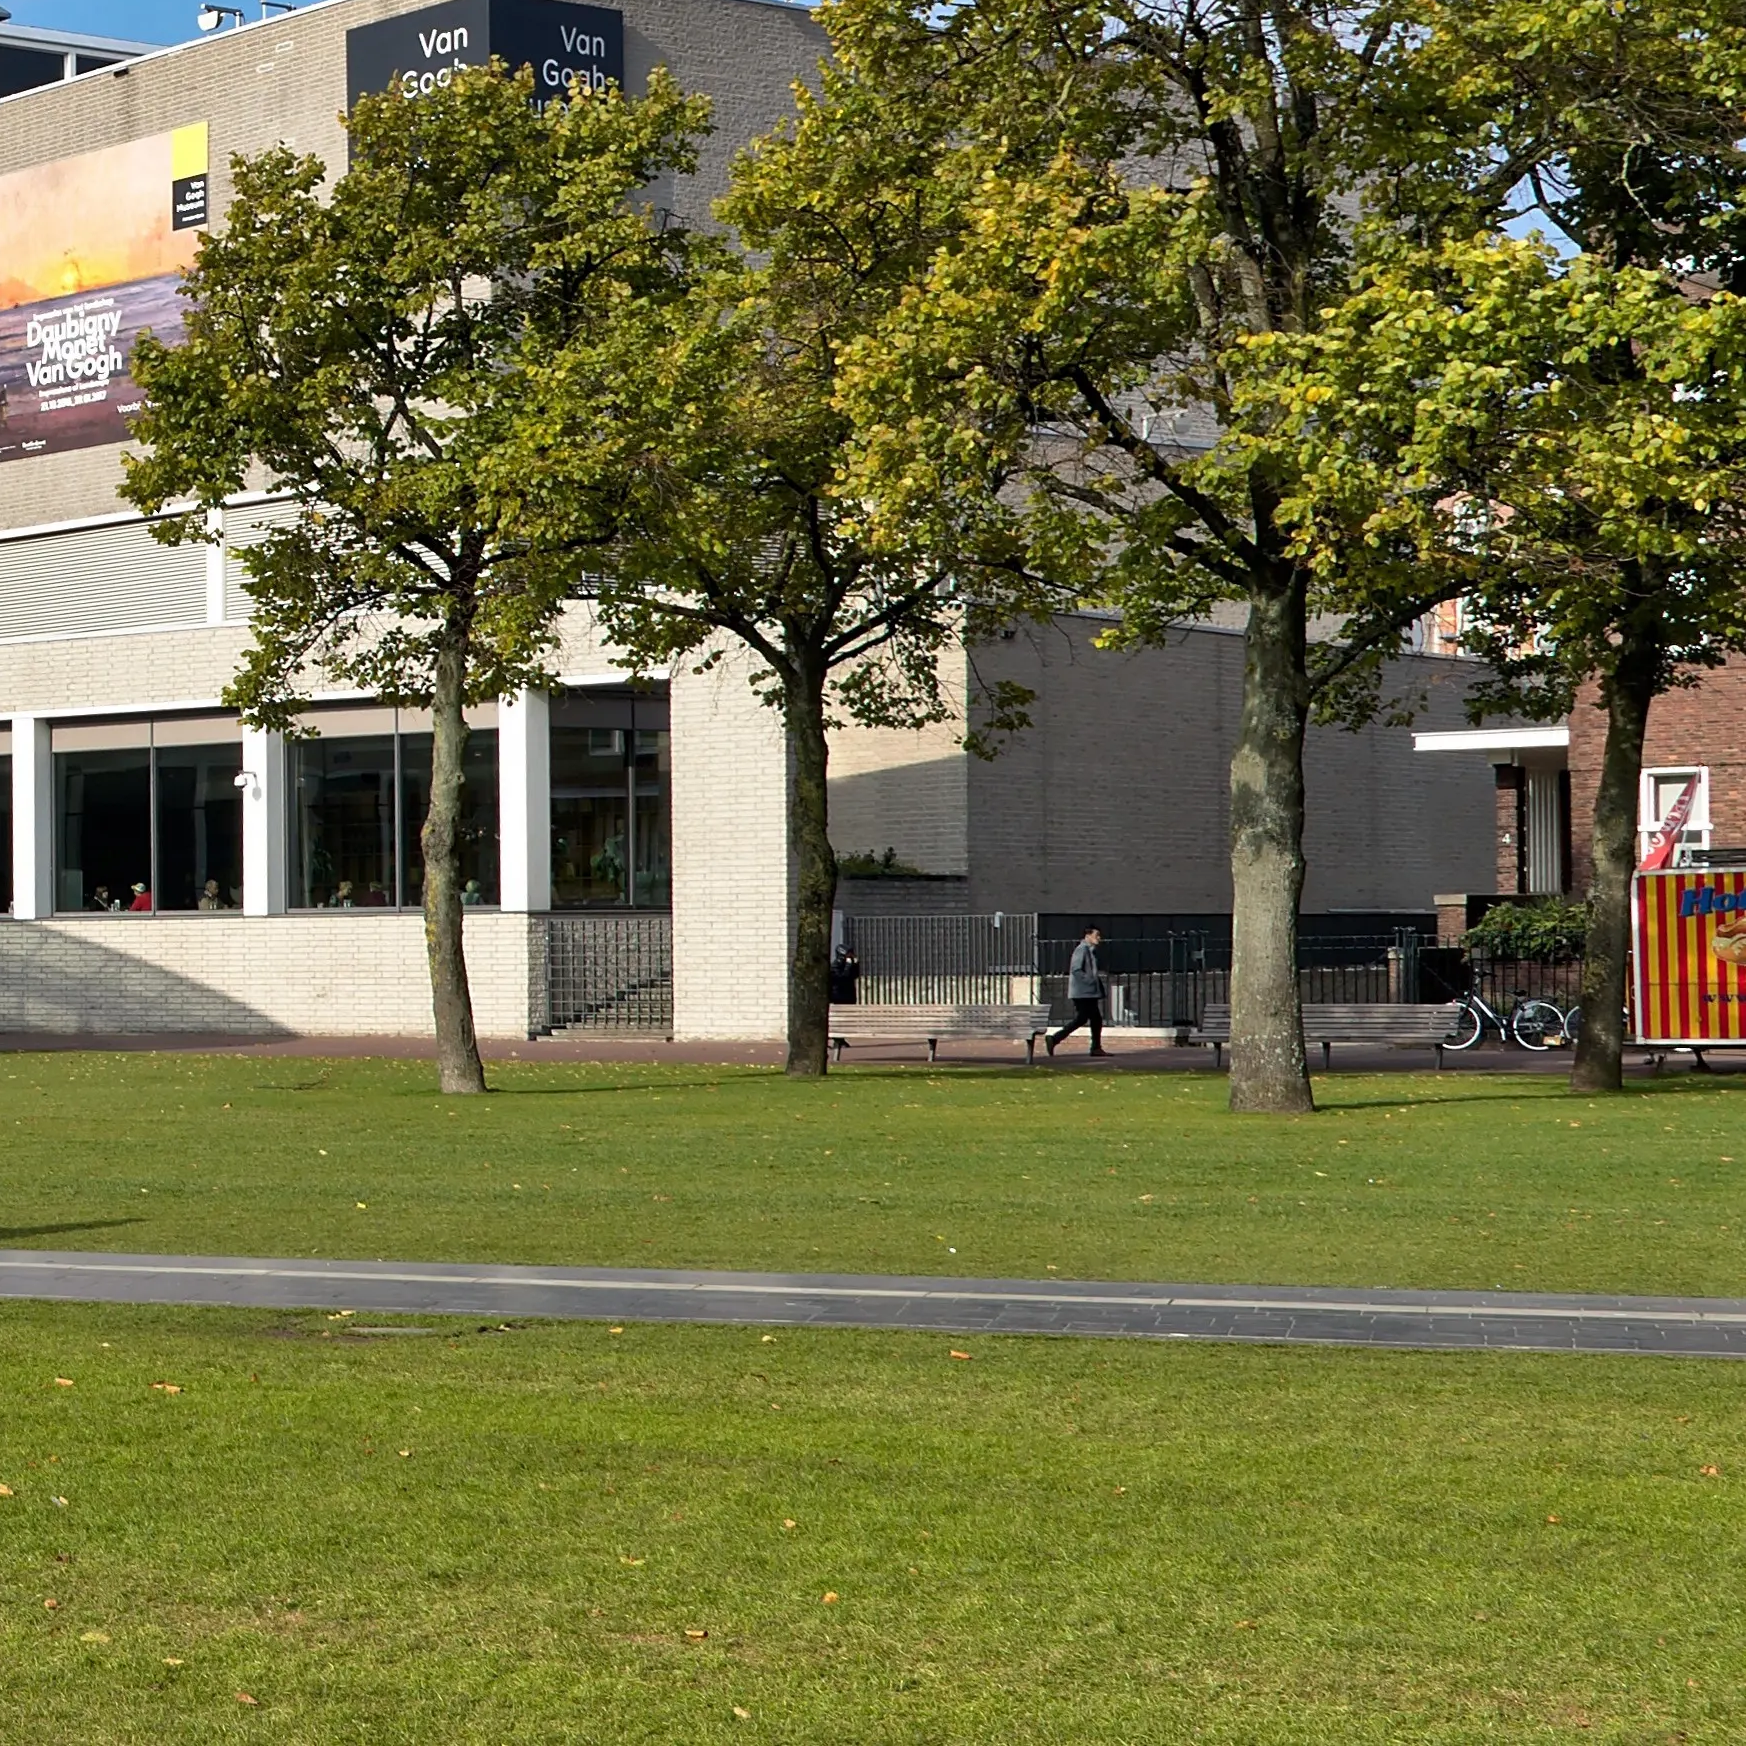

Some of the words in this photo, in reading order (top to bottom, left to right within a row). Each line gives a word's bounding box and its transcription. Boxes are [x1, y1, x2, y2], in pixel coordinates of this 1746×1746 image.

[418, 27, 468, 58] Van
[560, 25, 605, 57] Van
[26, 309, 122, 348] Daubigny
[42, 331, 106, 364] Monet
[26, 360, 64, 387] Van
[66, 345, 123, 381] Gogh
[1501, 833, 1511, 844] 4
